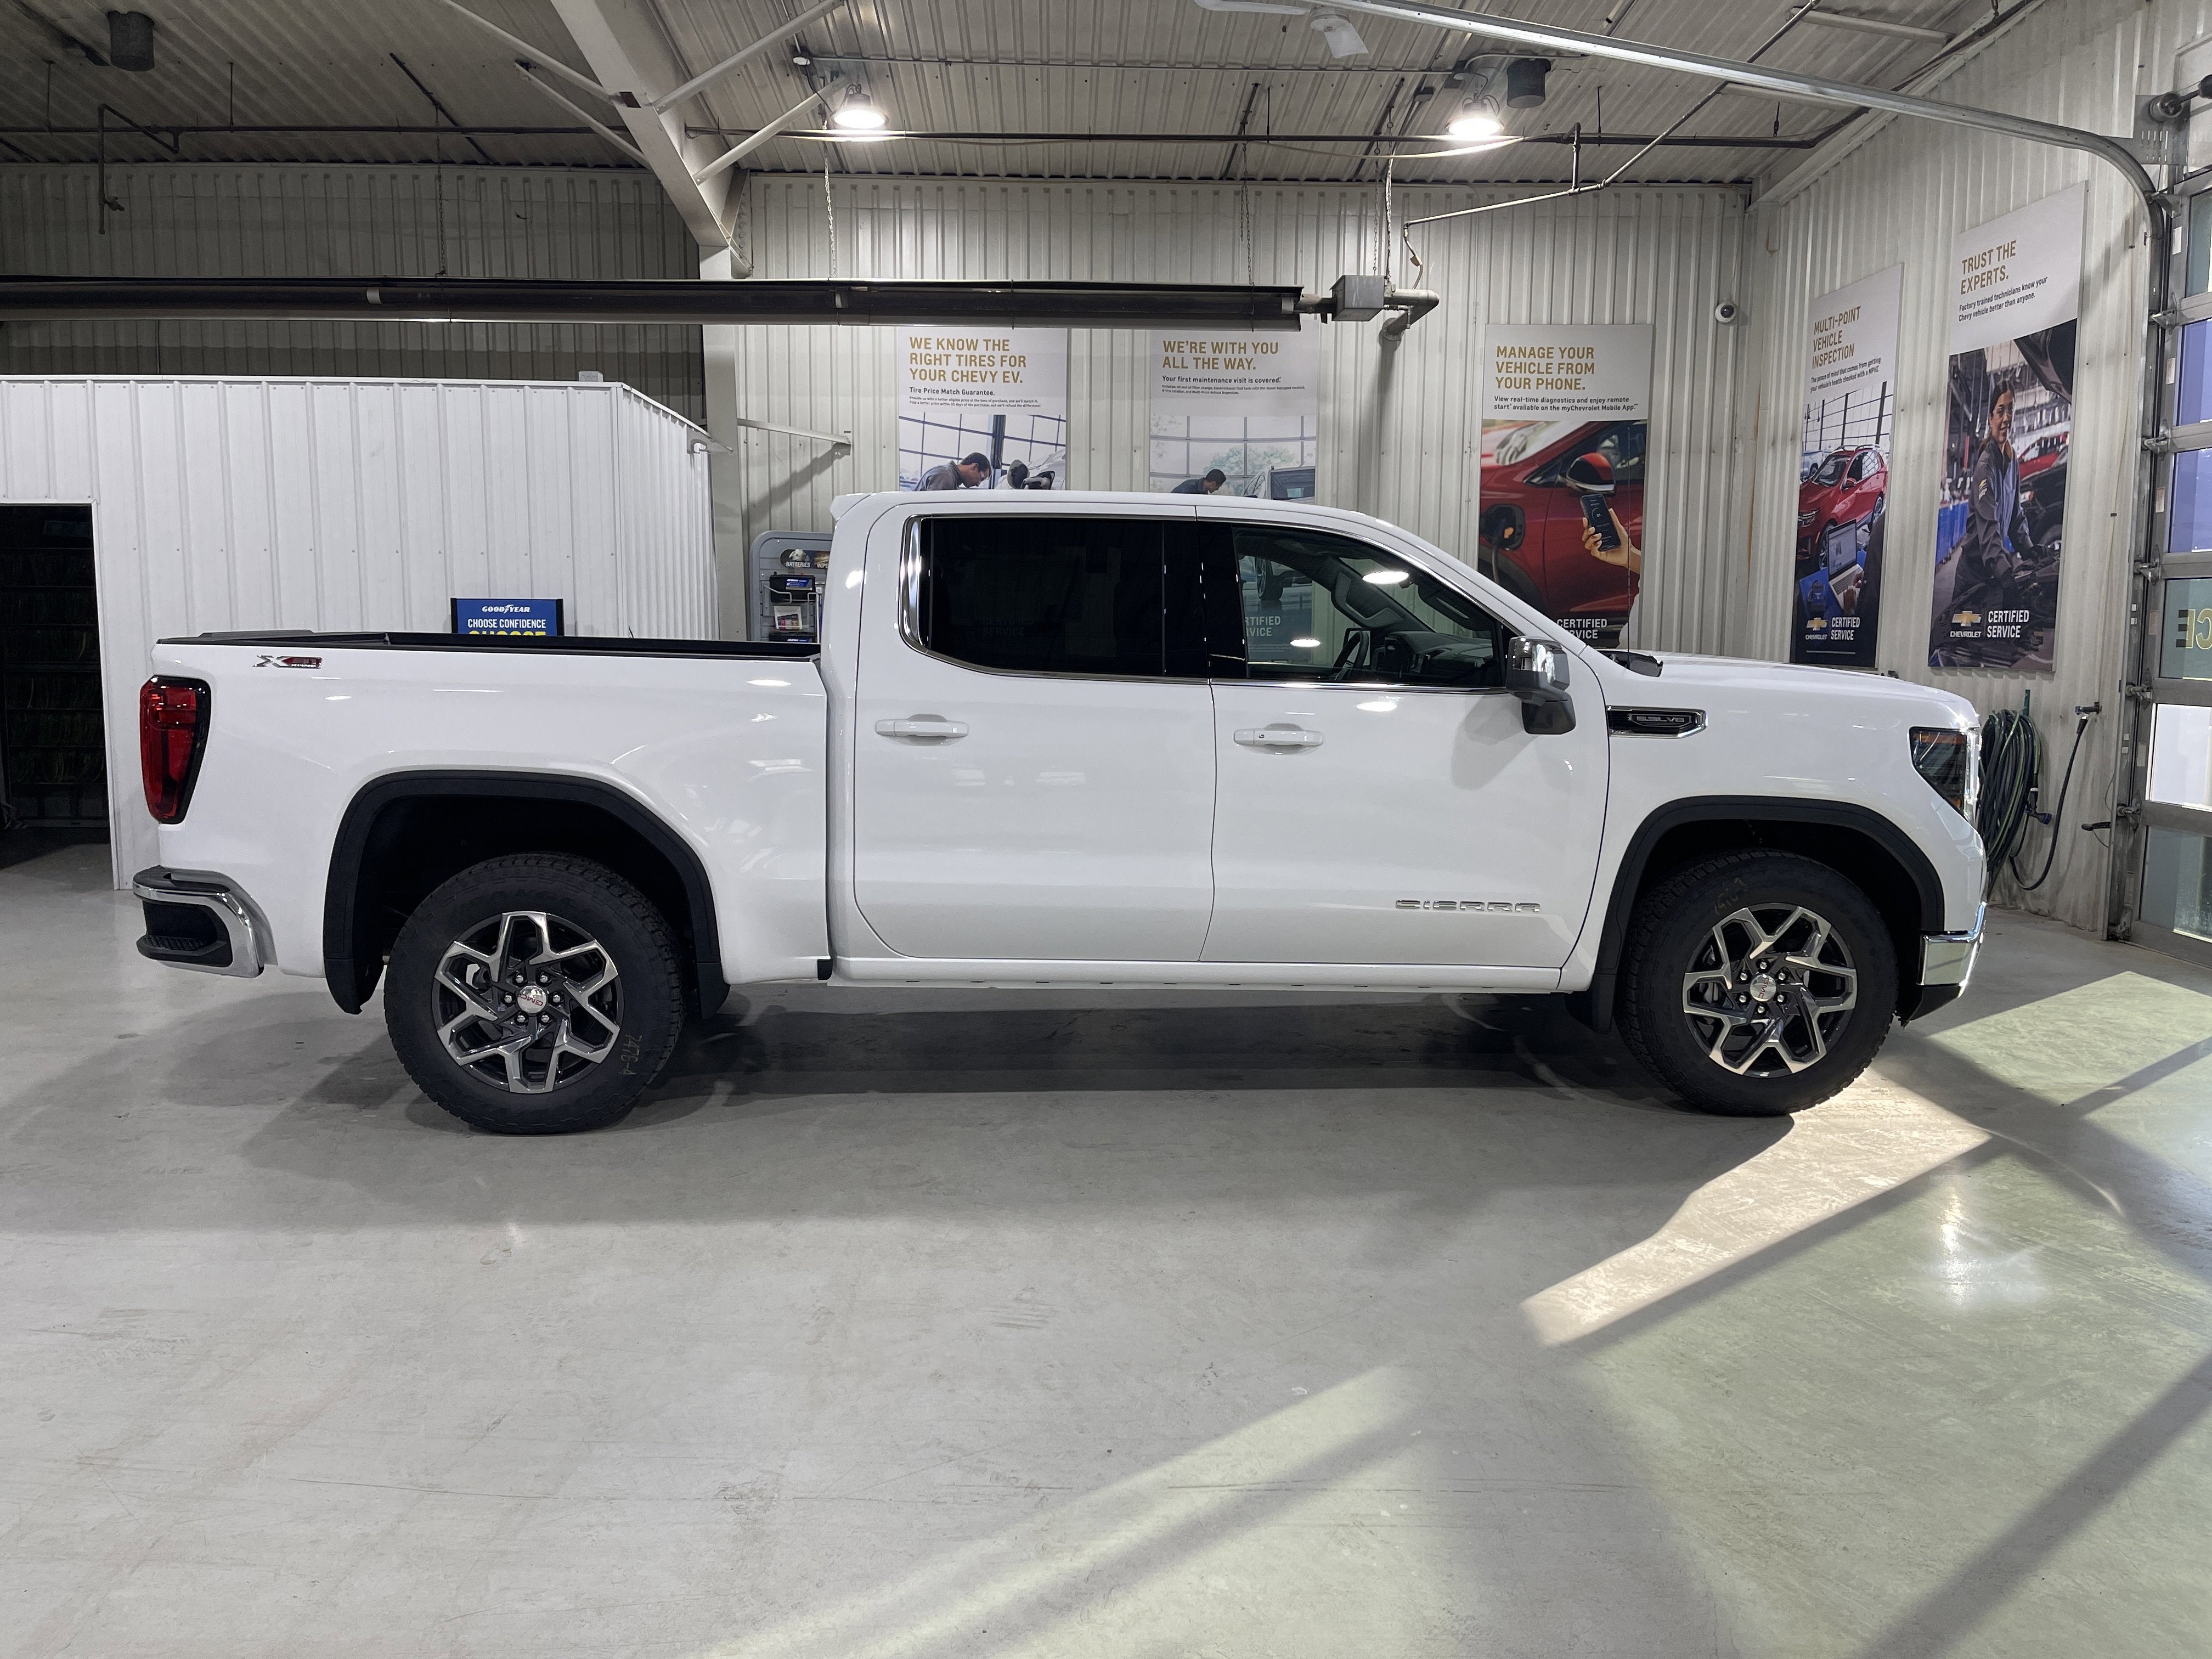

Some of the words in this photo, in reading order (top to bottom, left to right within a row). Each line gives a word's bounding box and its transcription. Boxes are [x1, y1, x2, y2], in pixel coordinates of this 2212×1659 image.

[1962, 249, 1994, 275] TRUST
[1996, 240, 2016, 262] THE
[1960, 265, 2009, 295] EXPERTS.
[1959, 301, 1976, 312] Factory
[1977, 294, 1993, 306] trained
[1994, 286, 2021, 301] technicians
[2022, 281, 2035, 291] know
[2036, 276, 2048, 288] your
[1959, 313, 1972, 321] Chevy
[1972, 307, 1988, 317] vehicle
[1989, 302, 2004, 313] better
[2005, 299, 2016, 308] than
[1814, 306, 1861, 335] MULTI-POINT
[910, 337, 932, 349] WE
[936, 338, 979, 351] KNOW
[983, 339, 1010, 352] THE
[1163, 340, 1206, 354] WE'RE
[1211, 342, 1246, 354] WITH
[1251, 342, 1278, 354] YOU
[1813, 330, 1842, 352] VEHICLE
[1496, 346, 1554, 359] MANAGE
[1558, 347, 1594, 359] YOUR
[1812, 343, 1854, 370] INSPECTION
[910, 352, 951, 366] RIGHT
[956, 354, 995, 367] TIRES
[1000, 355, 1026, 368] FOR
[1162, 356, 1189, 369] ALL
[1193, 357, 1219, 369] THE
[1223, 358, 1256, 370] WAY.
[1496, 362, 1553, 375] VEHICLE
[1557, 363, 1595, 375] FROM
[910, 368, 946, 381] YOUR
[951, 370, 998, 382] CHEVY
[1003, 371, 1023, 383] EV.
[1496, 376, 1531, 390] YOUR
[1536, 378, 1585, 391] PHONE.
[482, 604, 531, 613] GOODYEAR
[1245, 616, 1281, 625] RTIFIED
[1557, 618, 1607, 628] CERTIFIED
[1832, 617, 1860, 628] CERTIFIED
[1988, 610, 2029, 623] CERTIFIED
[468, 619, 498, 628] CHOOSE
[499, 619, 546, 628] CONFIDENCE
[1246, 628, 1272, 636] VICE
[1568, 629, 1598, 639] RVICE
[1831, 630, 1854, 640] SERVICE
[1987, 625, 2021, 638] SERVICE
[1395, 900, 1540, 912] SIERRA
[1758, 978, 1769, 1000] GMC
[520, 994, 543, 1006] GMC
